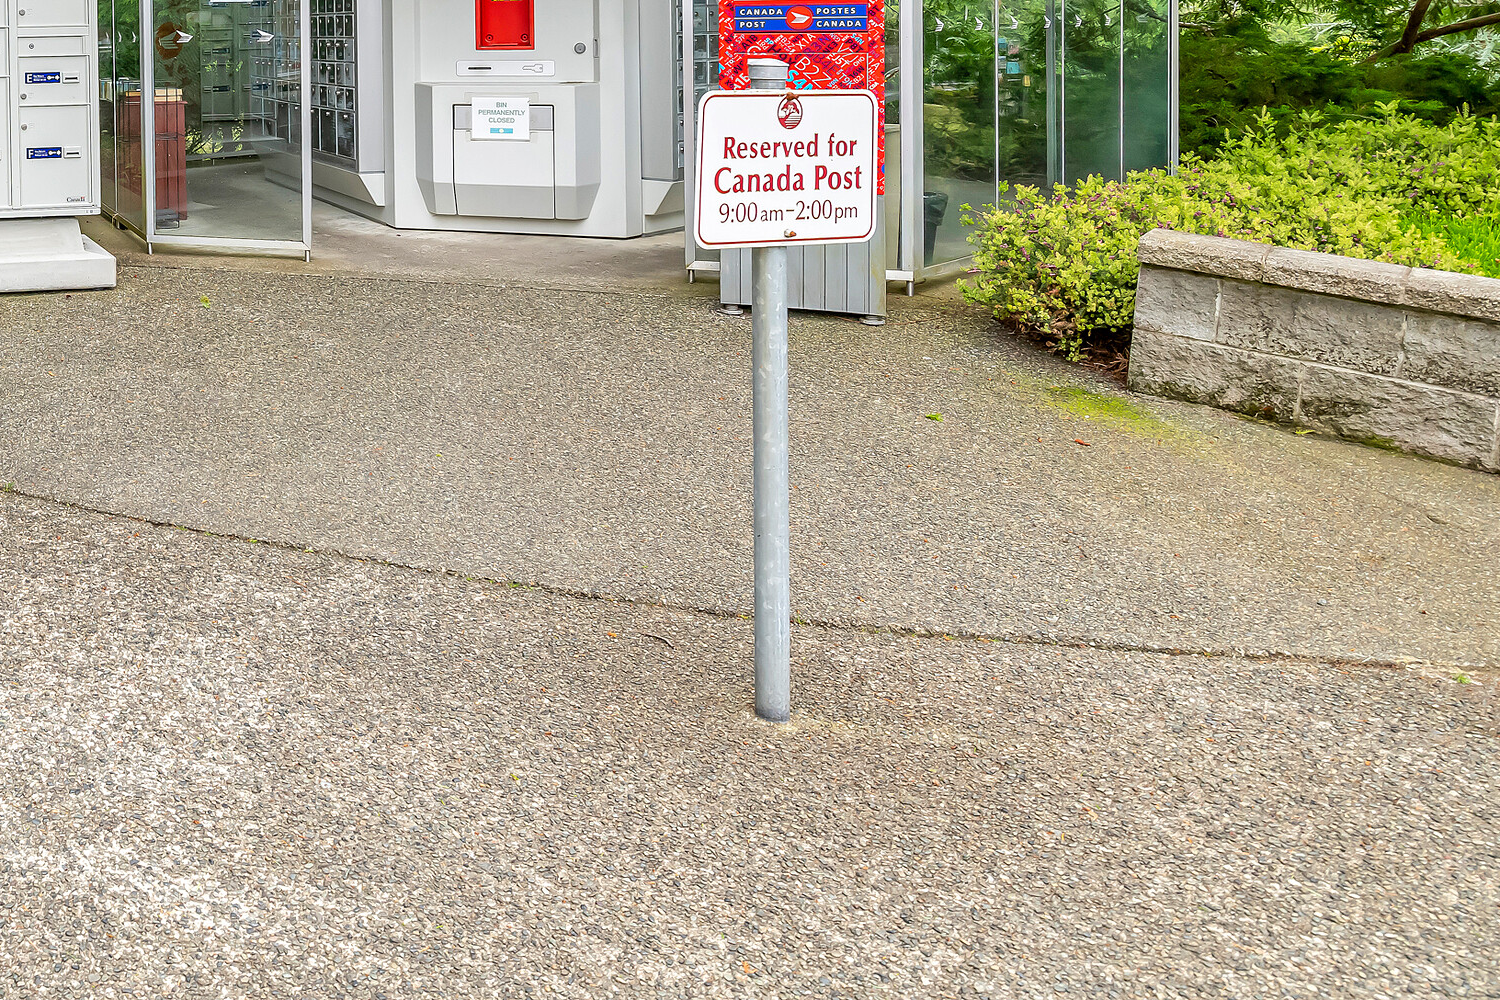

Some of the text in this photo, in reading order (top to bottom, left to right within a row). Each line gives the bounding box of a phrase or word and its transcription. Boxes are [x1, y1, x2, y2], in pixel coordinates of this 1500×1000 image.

[739, 7, 856, 16] CANADA POSTES
[816, 20, 862, 28] CANADA
[742, 34, 758, 49] A1B
[26, 73, 33, 83] E
[794, 56, 832, 88] B2Z
[723, 132, 858, 160] Reserved for
[28, 149, 34, 158] F
[714, 164, 862, 194] Canada Post
